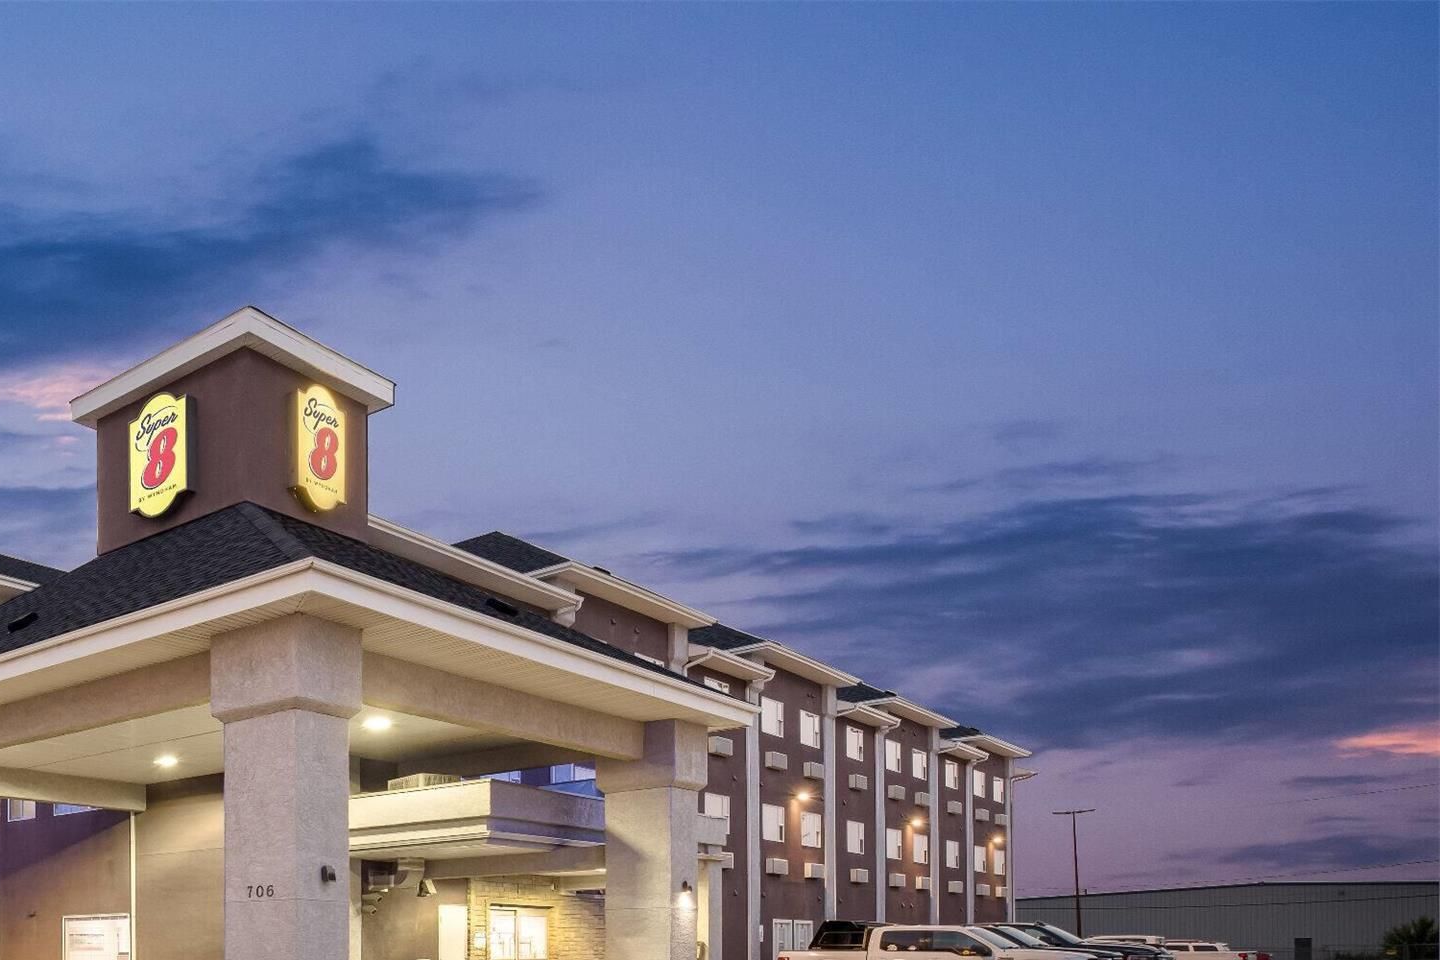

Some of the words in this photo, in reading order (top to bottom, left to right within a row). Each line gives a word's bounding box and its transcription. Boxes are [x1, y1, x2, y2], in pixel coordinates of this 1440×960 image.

[135, 412, 178, 446] Super
[304, 397, 339, 430] Super
[141, 427, 177, 489] 8
[309, 427, 338, 480] 8
[247, 884, 275, 899] 706
